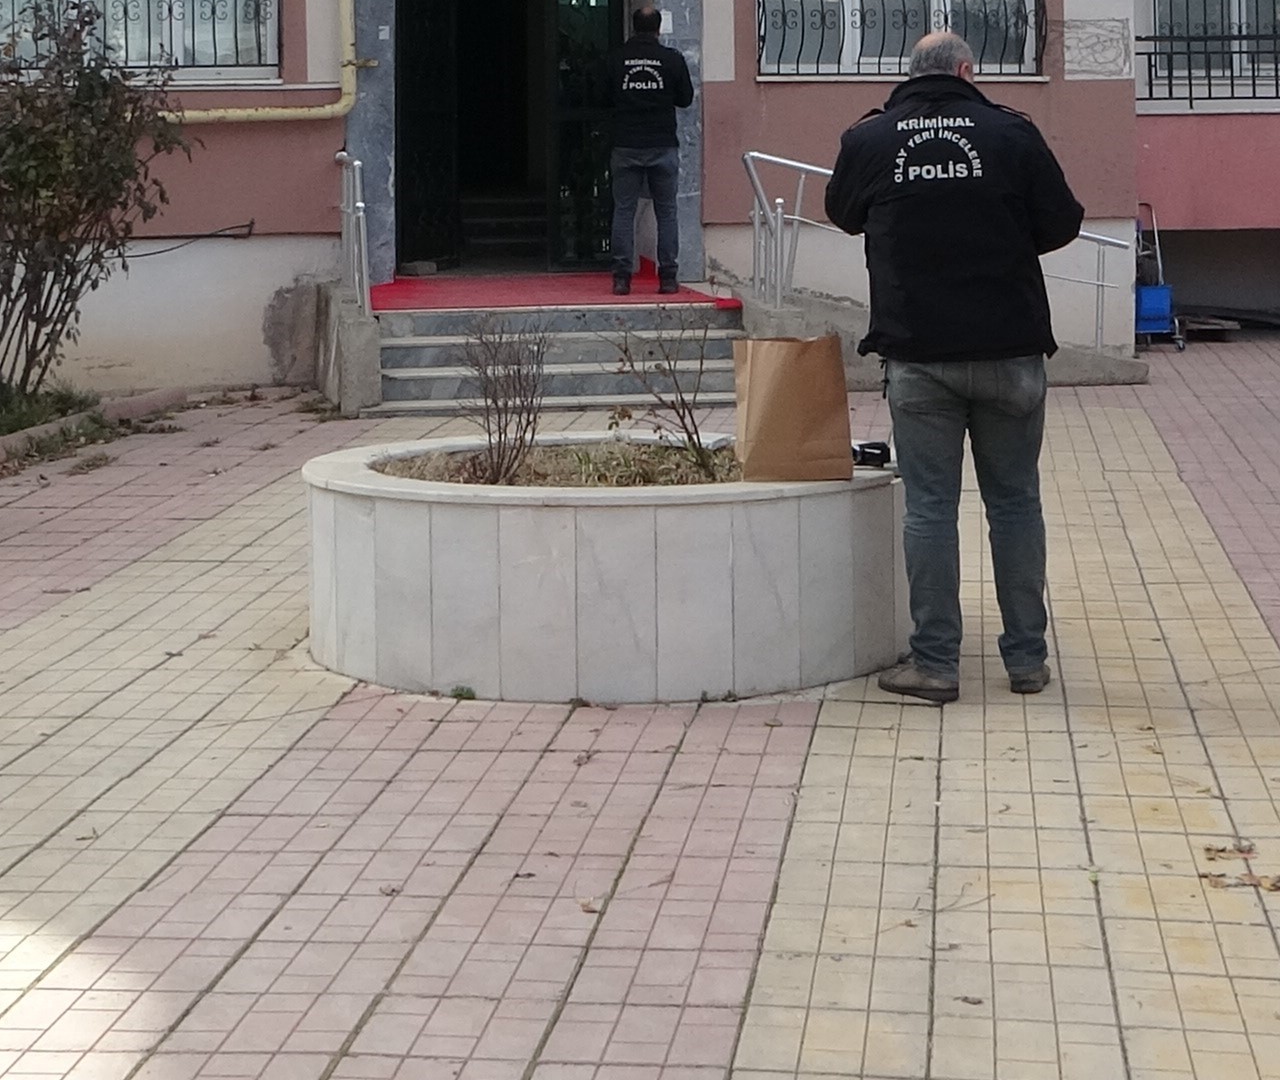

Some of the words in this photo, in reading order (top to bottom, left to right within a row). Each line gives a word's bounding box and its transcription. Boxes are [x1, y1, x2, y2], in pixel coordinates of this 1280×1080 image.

[896, 116, 975, 131] KRİMİNAL
[894, 148, 908, 183] OLAY
[907, 160, 969, 181] POLİS
